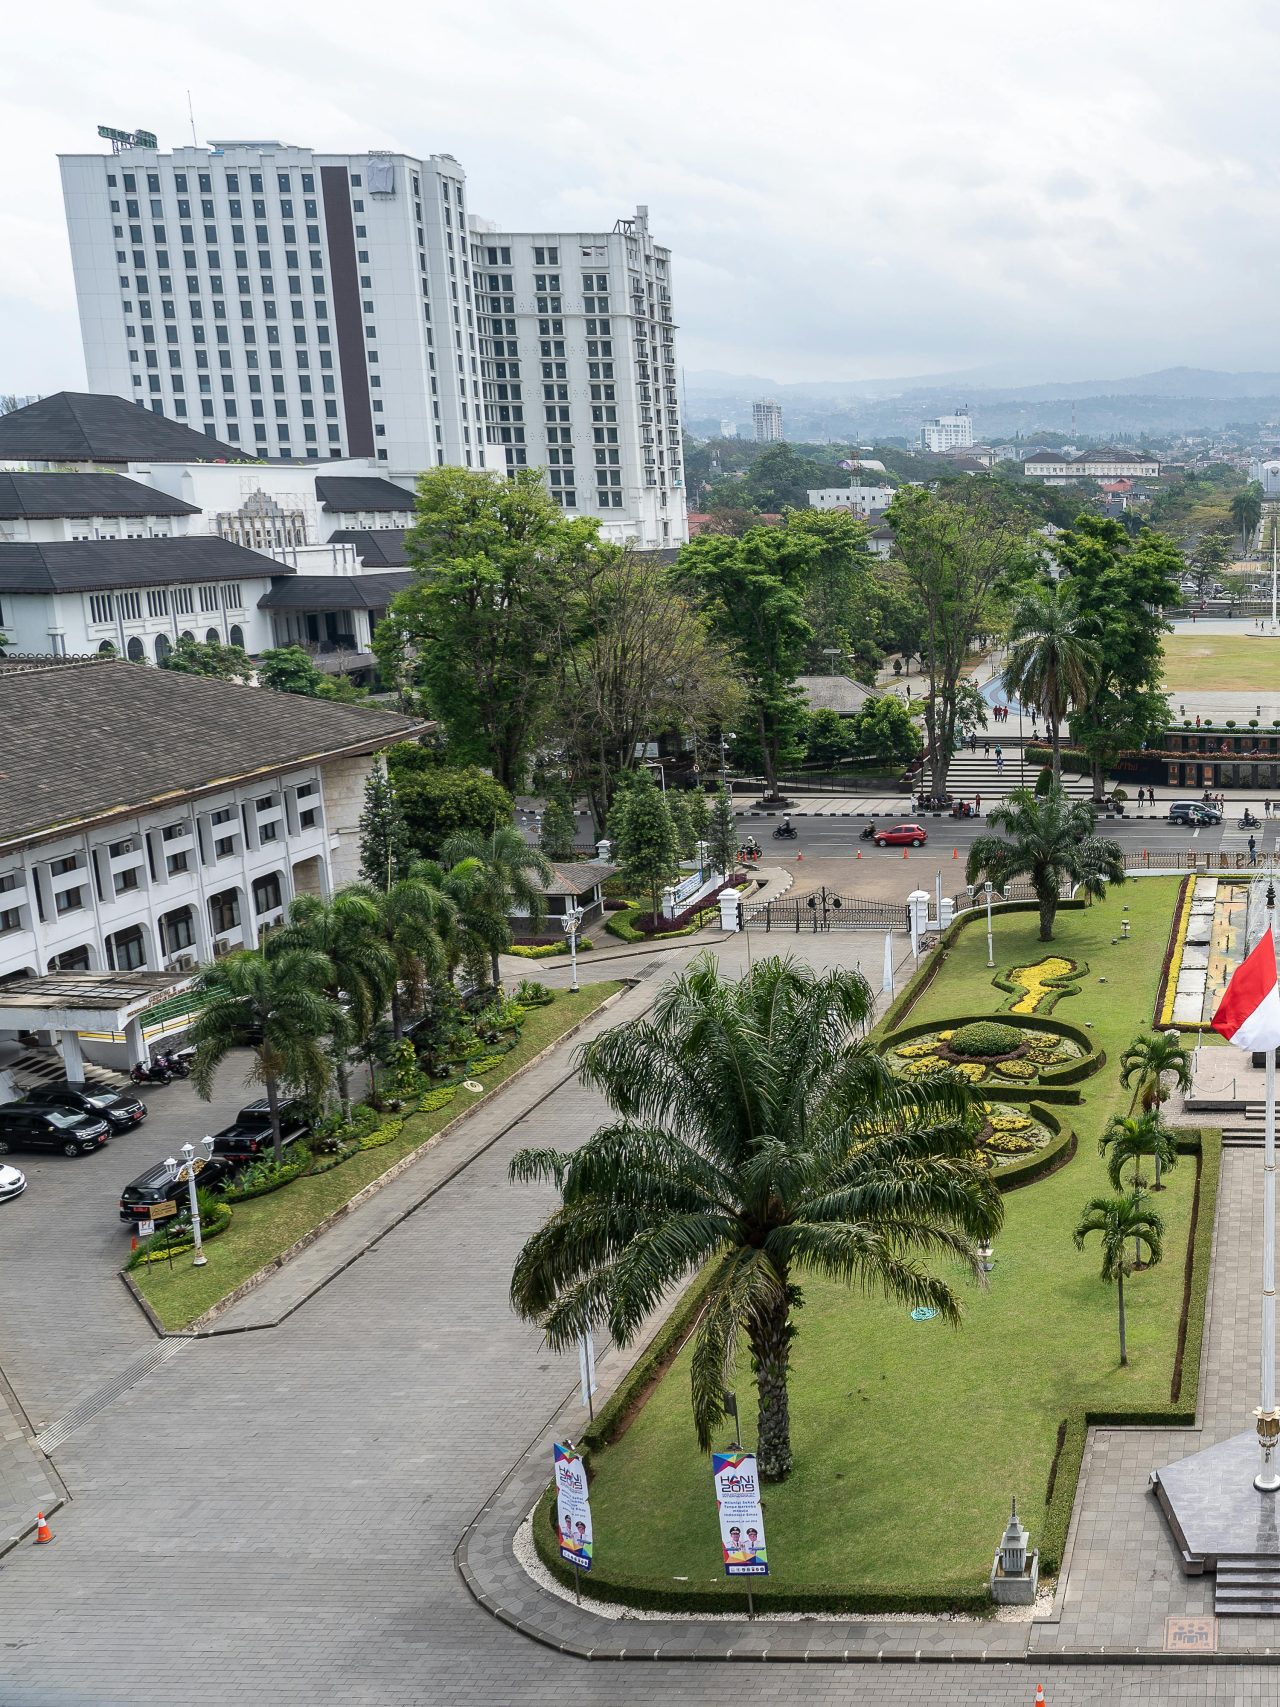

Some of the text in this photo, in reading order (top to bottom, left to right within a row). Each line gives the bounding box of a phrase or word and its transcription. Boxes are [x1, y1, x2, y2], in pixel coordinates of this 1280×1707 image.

[559, 1465, 582, 1483] HANI
[720, 1475, 753, 1485] HANI
[560, 1473, 583, 1490] 2019
[721, 1484, 755, 1492] 2019
